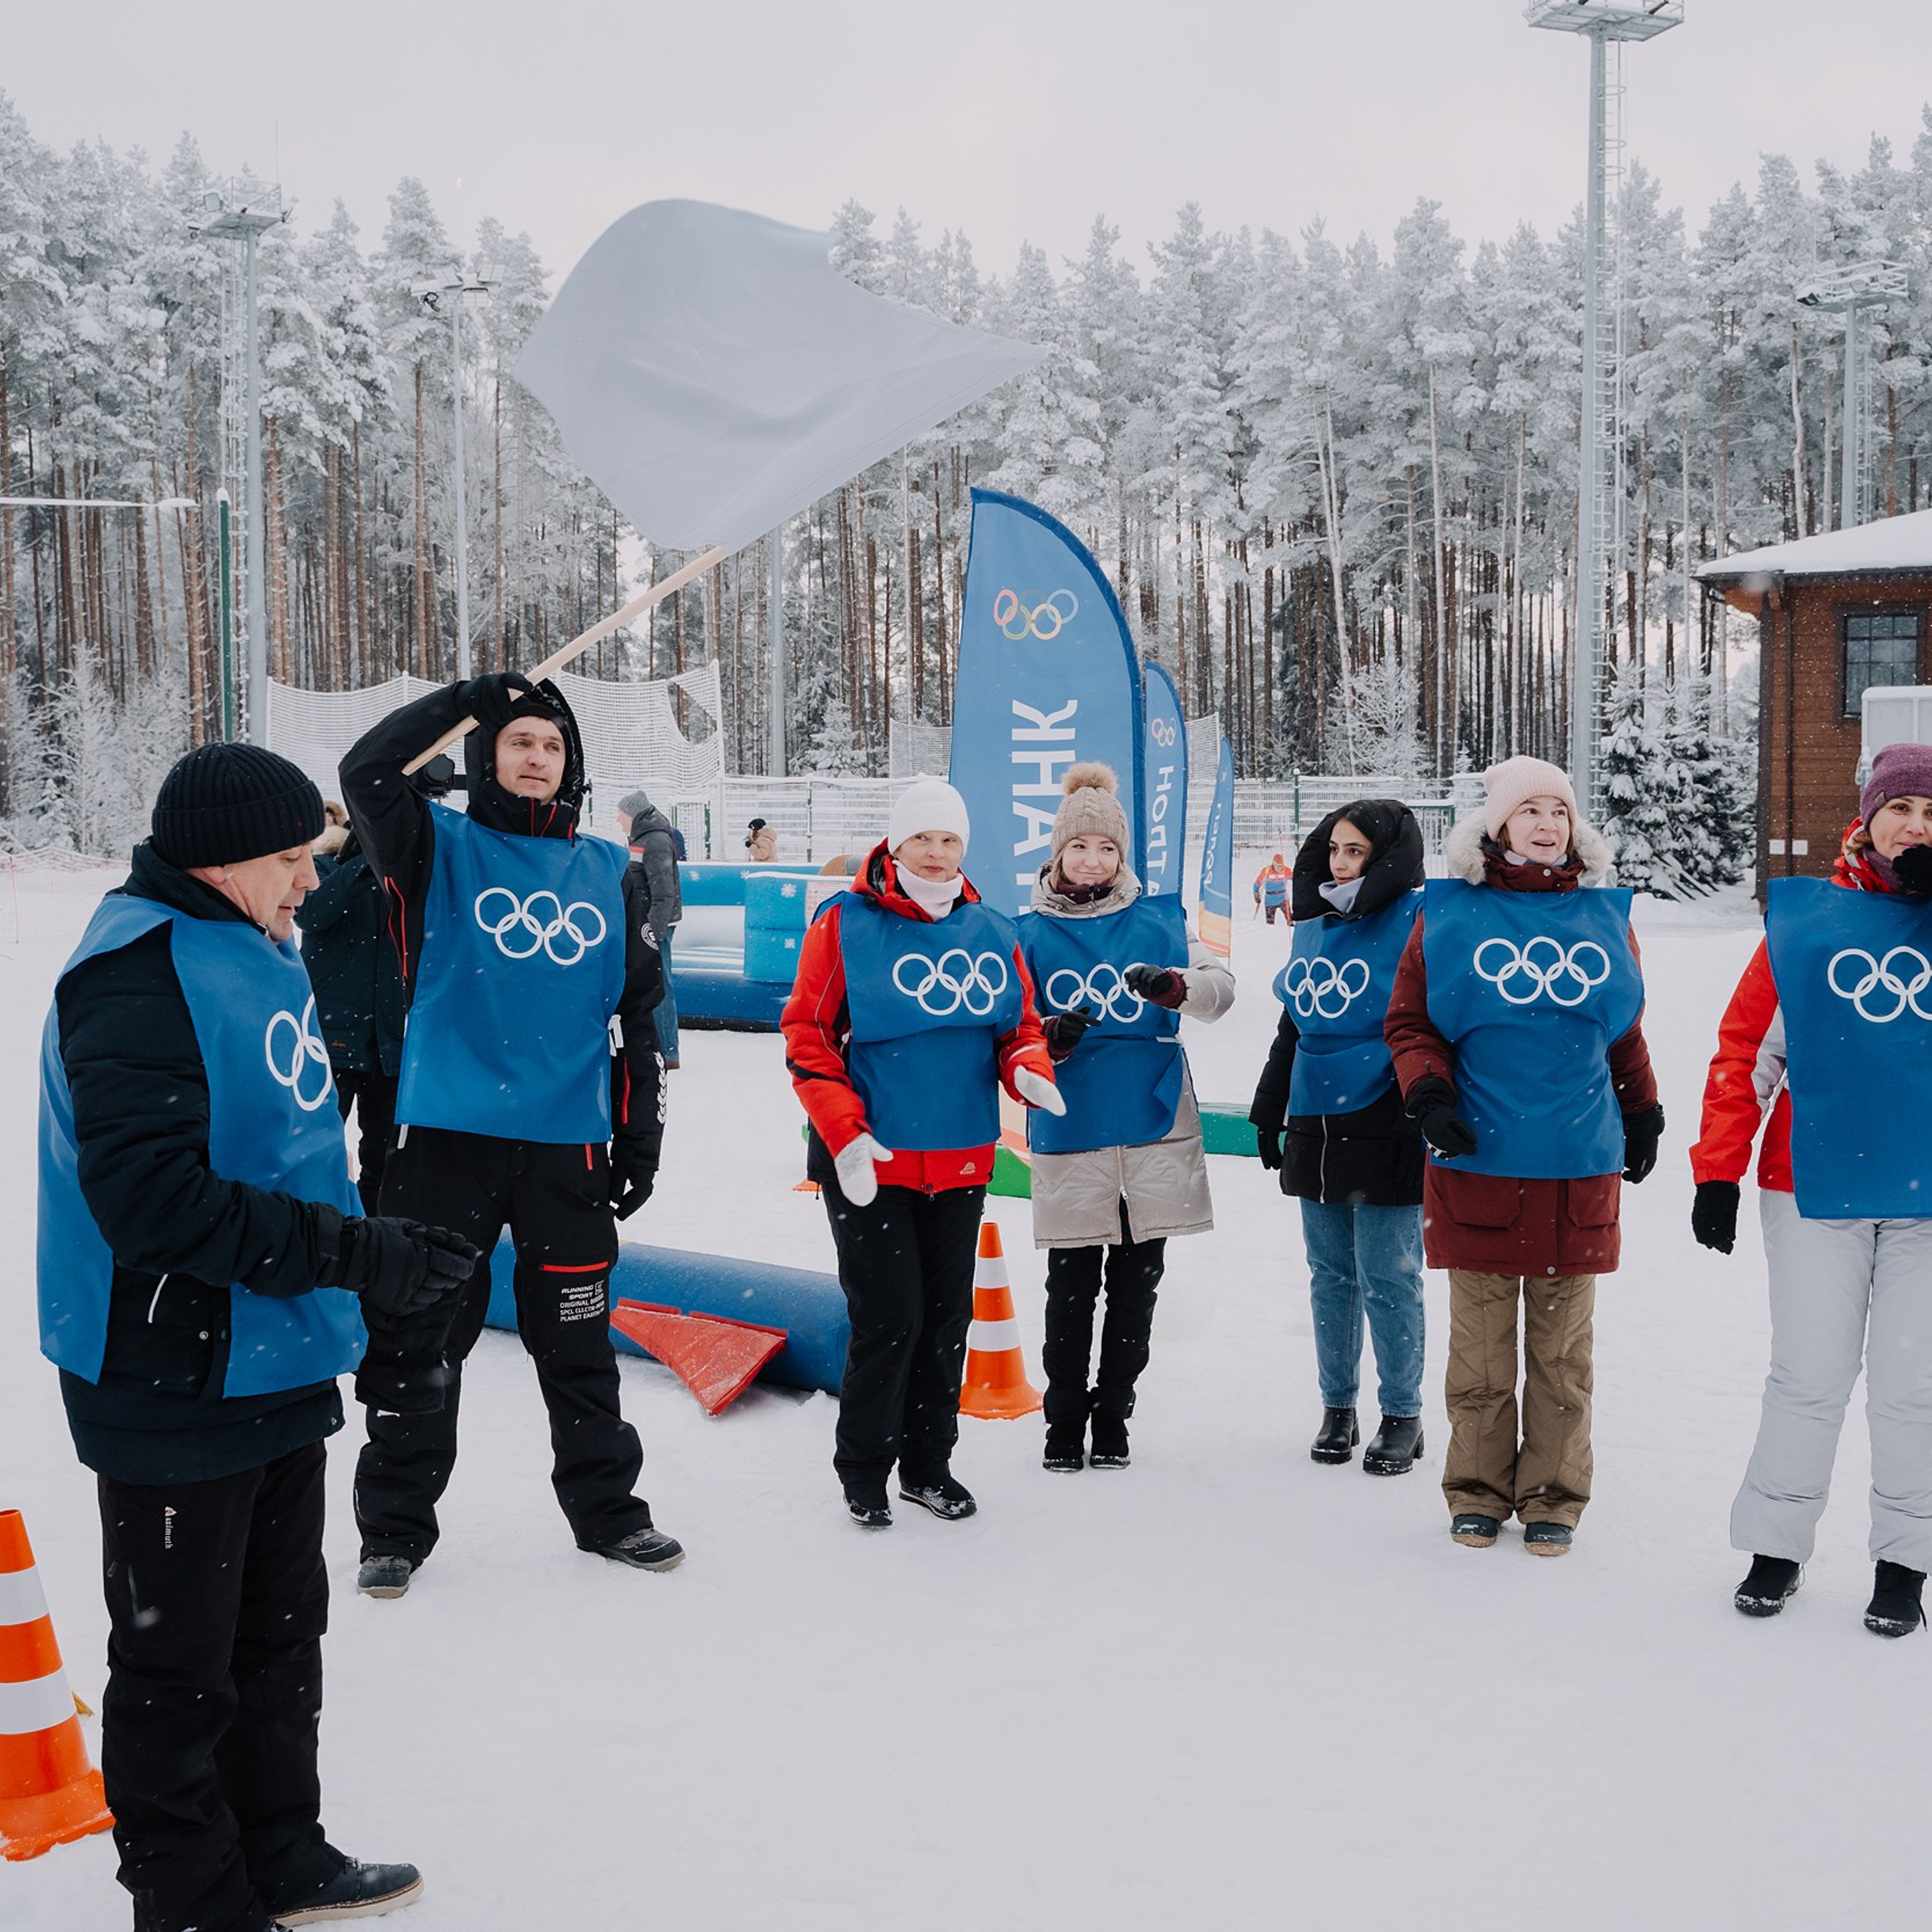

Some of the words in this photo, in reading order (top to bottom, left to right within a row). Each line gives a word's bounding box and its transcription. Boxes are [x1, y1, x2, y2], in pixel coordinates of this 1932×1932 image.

[561, 1284, 594, 1294] RUNNING
[568, 1292, 593, 1300] SPORT
[560, 1300, 589, 1309] ORIGINAL
[560, 1314, 582, 1322] PLANET
